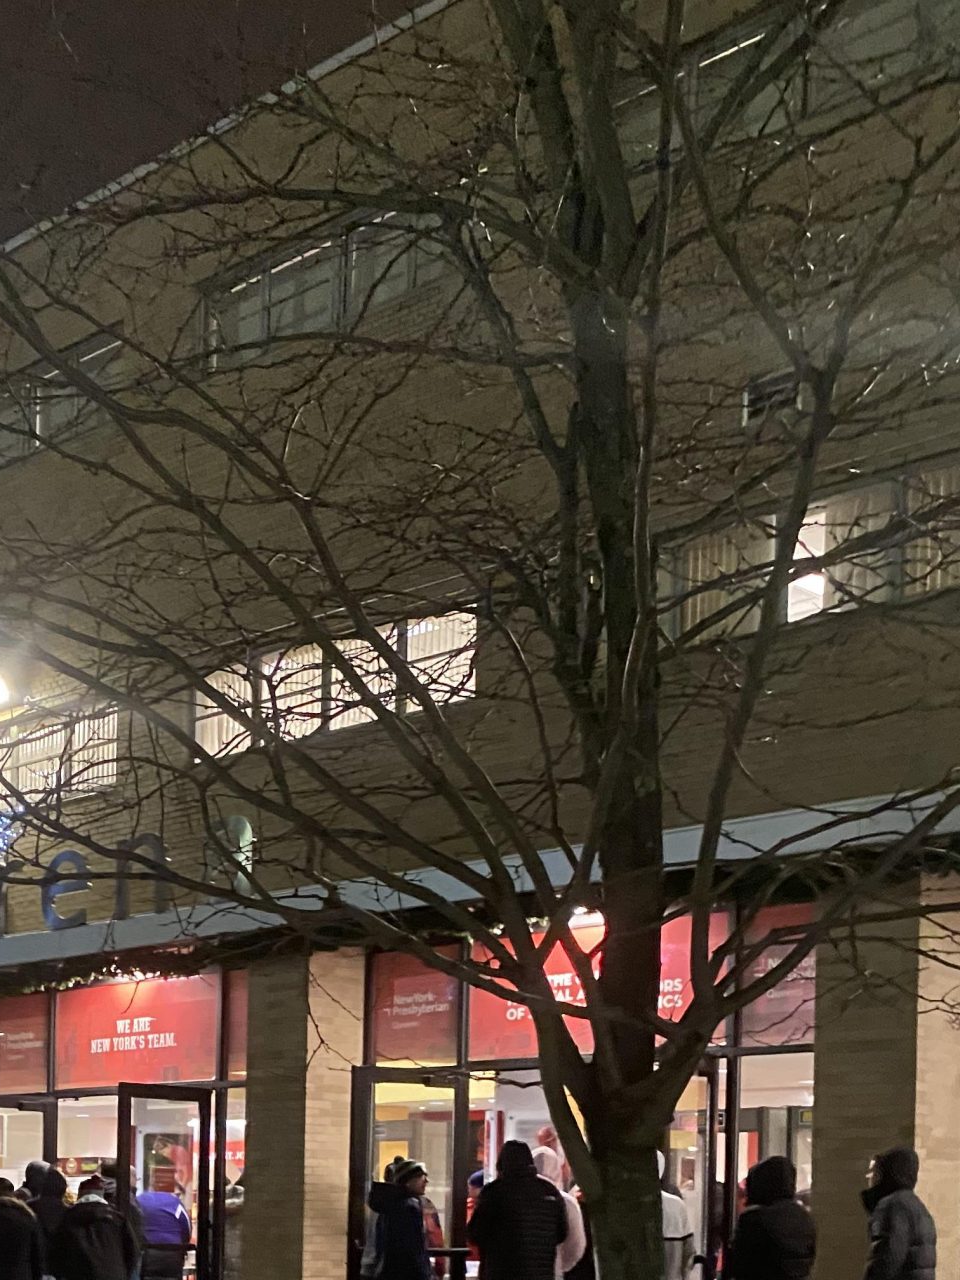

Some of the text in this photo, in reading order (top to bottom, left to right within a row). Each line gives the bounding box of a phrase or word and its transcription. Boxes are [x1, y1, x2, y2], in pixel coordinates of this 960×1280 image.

[116, 1017, 151, 1034] WE ARE
[90, 1032, 177, 1053] NEW YORK'S TEAM.
